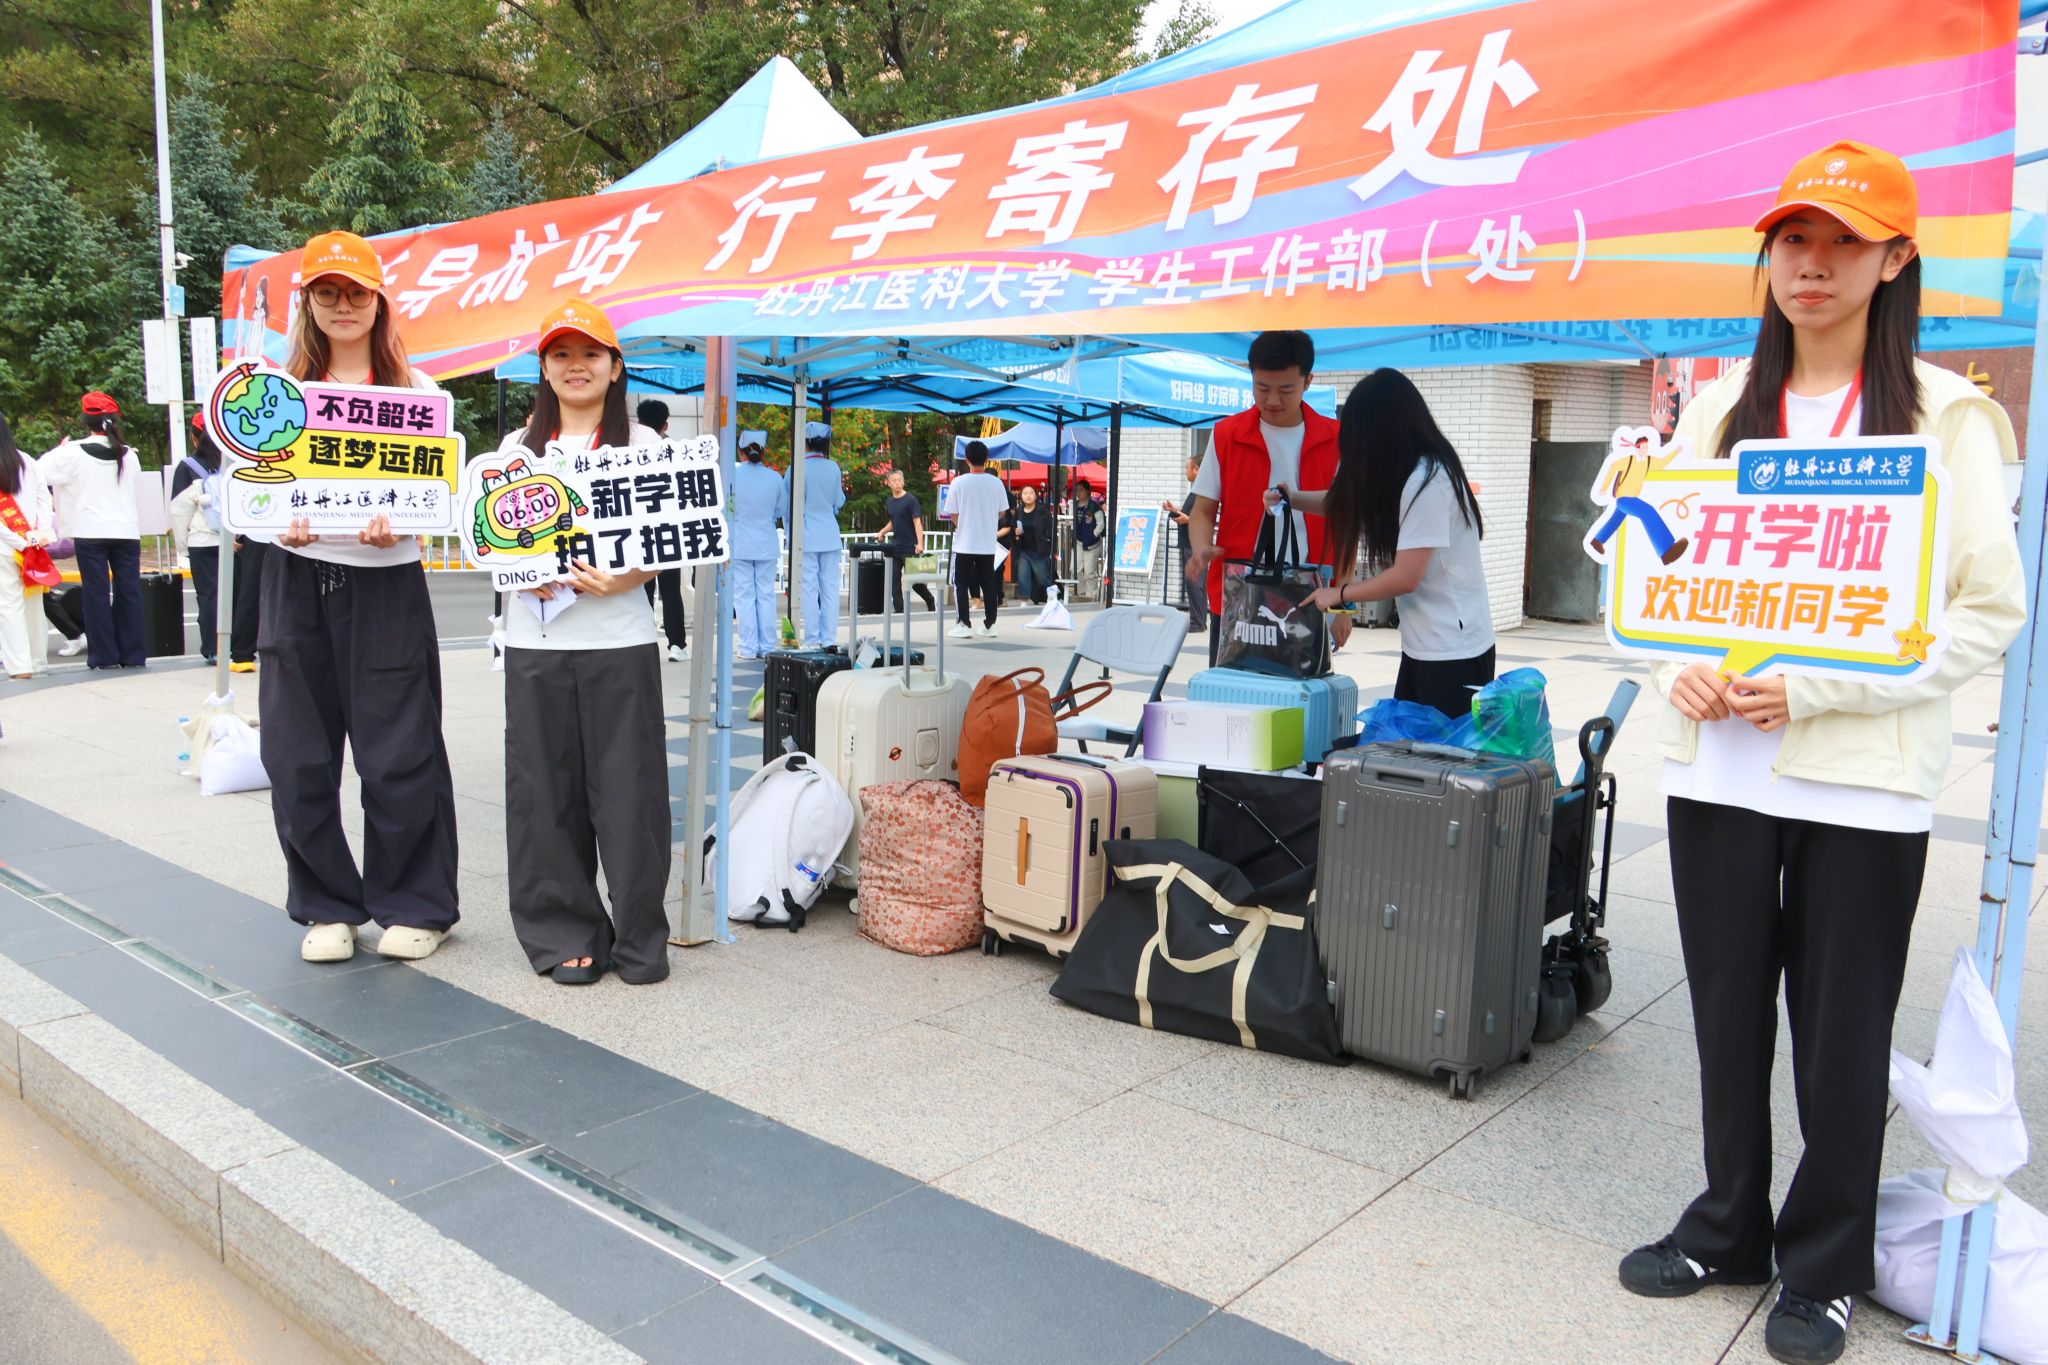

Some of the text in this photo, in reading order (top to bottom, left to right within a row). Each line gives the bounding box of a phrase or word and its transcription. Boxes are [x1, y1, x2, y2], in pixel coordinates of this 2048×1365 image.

[317, 394, 434, 431] 不负韶华
[309, 435, 445, 477] 逐梦远航
[575, 440, 714, 474] 牡丹江医科大学
[1784, 454, 1913, 478] 牡丹江医科大学
[291, 488, 439, 510] 牡丹江医科大学
[590, 468, 719, 520] 新学期
[1785, 478, 1910, 487] MUDANJIANG MEDICAL UNIVERSITY
[500, 493, 557, 526] 06:00
[554, 517, 723, 575] 拍了拍我
[1692, 503, 1891, 573] 开学啦
[499, 569, 537, 586] DING
[1640, 573, 1889, 638] 欢迎新同学
[1234, 621, 1277, 646] PUMA
